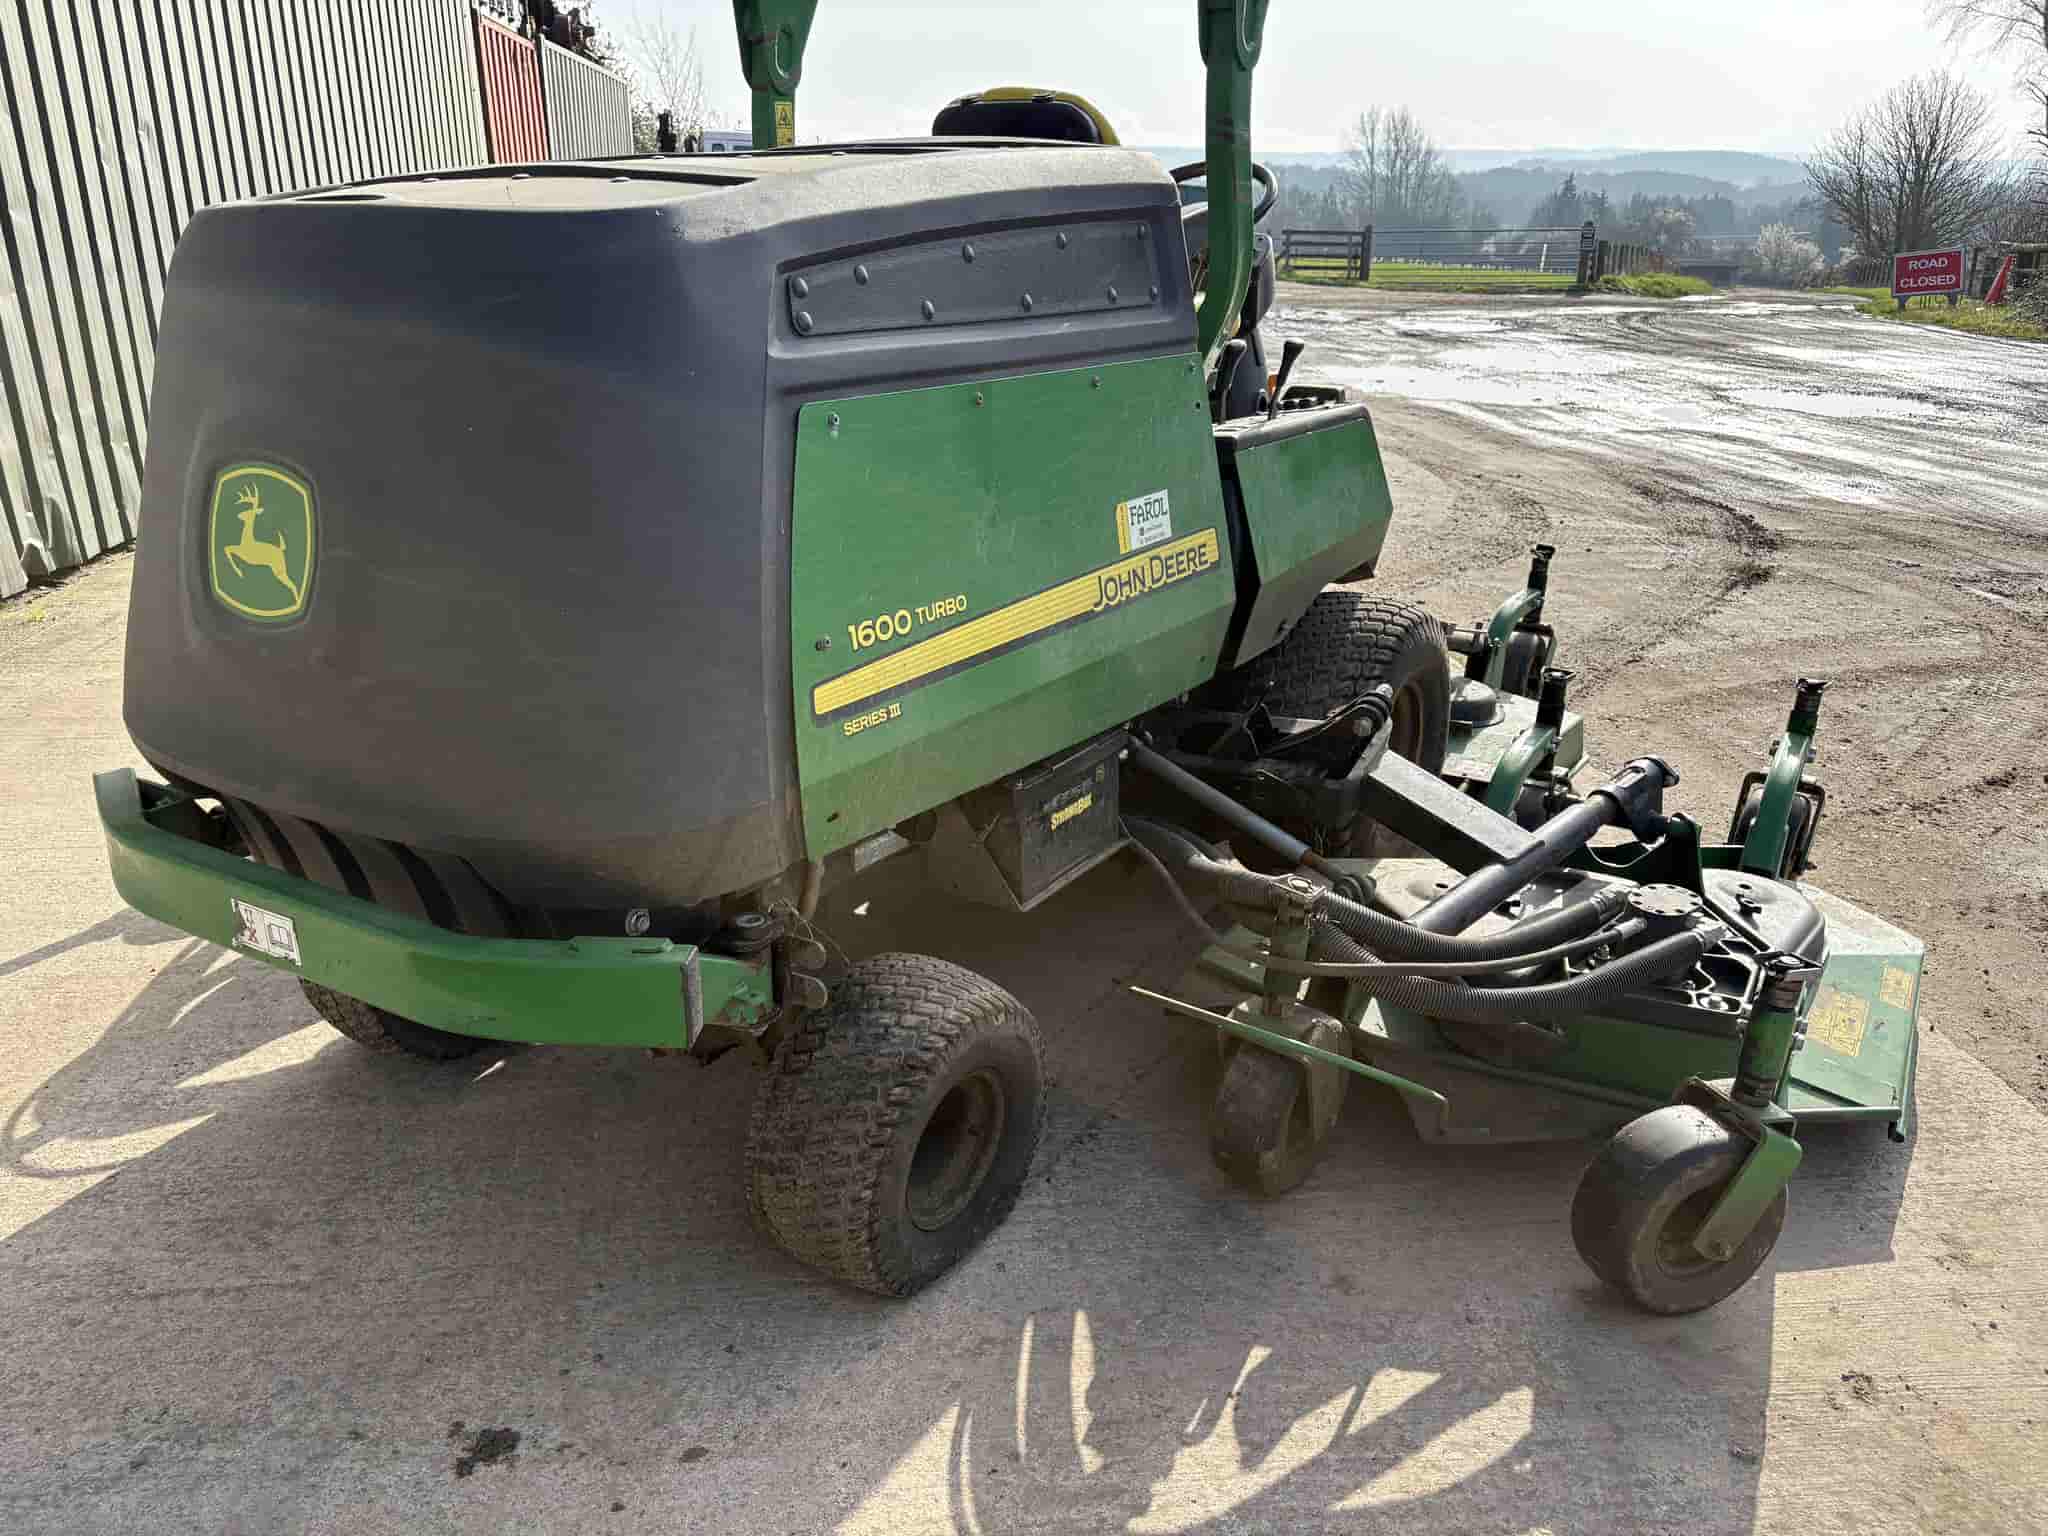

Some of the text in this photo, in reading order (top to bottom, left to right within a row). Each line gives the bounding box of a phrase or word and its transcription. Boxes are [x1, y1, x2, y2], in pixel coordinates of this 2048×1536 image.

[1909, 257, 1948, 271] ROAD
[1900, 274, 1956, 289] CLOSED
[1129, 497, 1168, 526] FAROL
[1094, 543, 1210, 609] JOHN DEERE
[847, 595, 967, 651] 1600 TURBO
[843, 703, 902, 736] SERIES III
